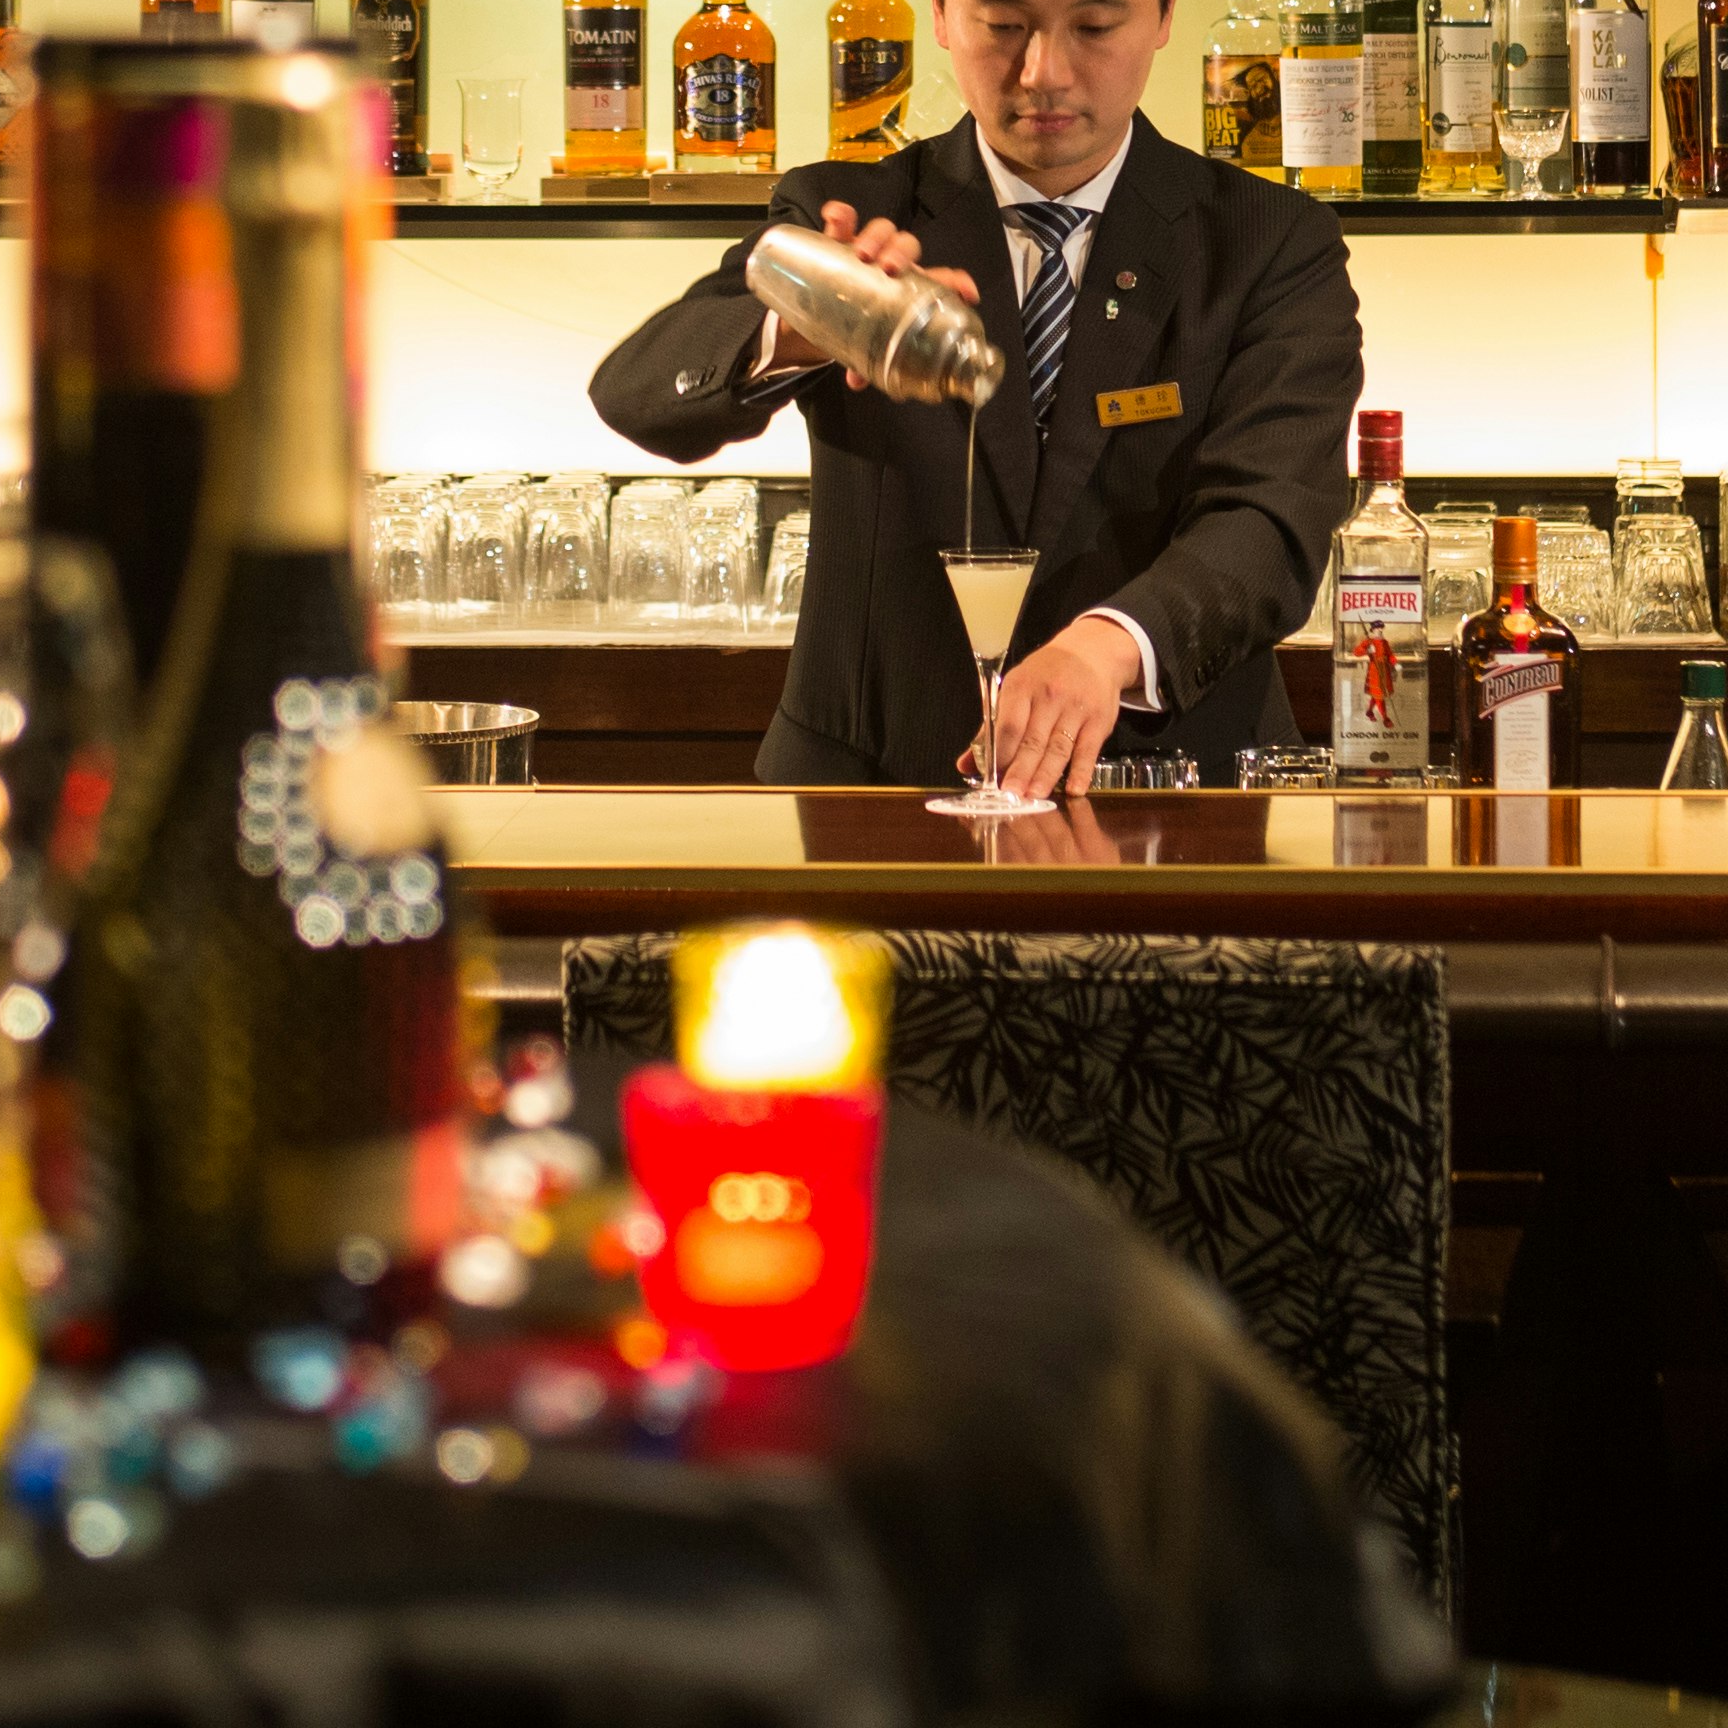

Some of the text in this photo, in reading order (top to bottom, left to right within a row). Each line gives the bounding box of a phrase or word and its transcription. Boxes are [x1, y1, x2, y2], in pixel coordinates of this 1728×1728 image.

[1300, 22, 1331, 35] MALT
[1333, 21, 1357, 34] CASK
[567, 28, 636, 47] TOMATIN
[1592, 29, 1616, 44] KA
[1593, 42, 1616, 57] VA
[1593, 54, 1628, 70] LAN
[688, 72, 724, 94] CHIVAS
[1405, 83, 1418, 97] 20
[592, 93, 611, 109] 18
[714, 89, 730, 103] 18
[1580, 87, 1614, 107] SOLIST
[1205, 106, 1238, 131] BIG
[1341, 110, 1356, 123] 20
[1205, 129, 1241, 147] PEAT
[1341, 591, 1419, 613] BEEFEATER
[1482, 662, 1562, 711] COINTREAU
[1340, 731, 1420, 740] LONDON DRY GIN
